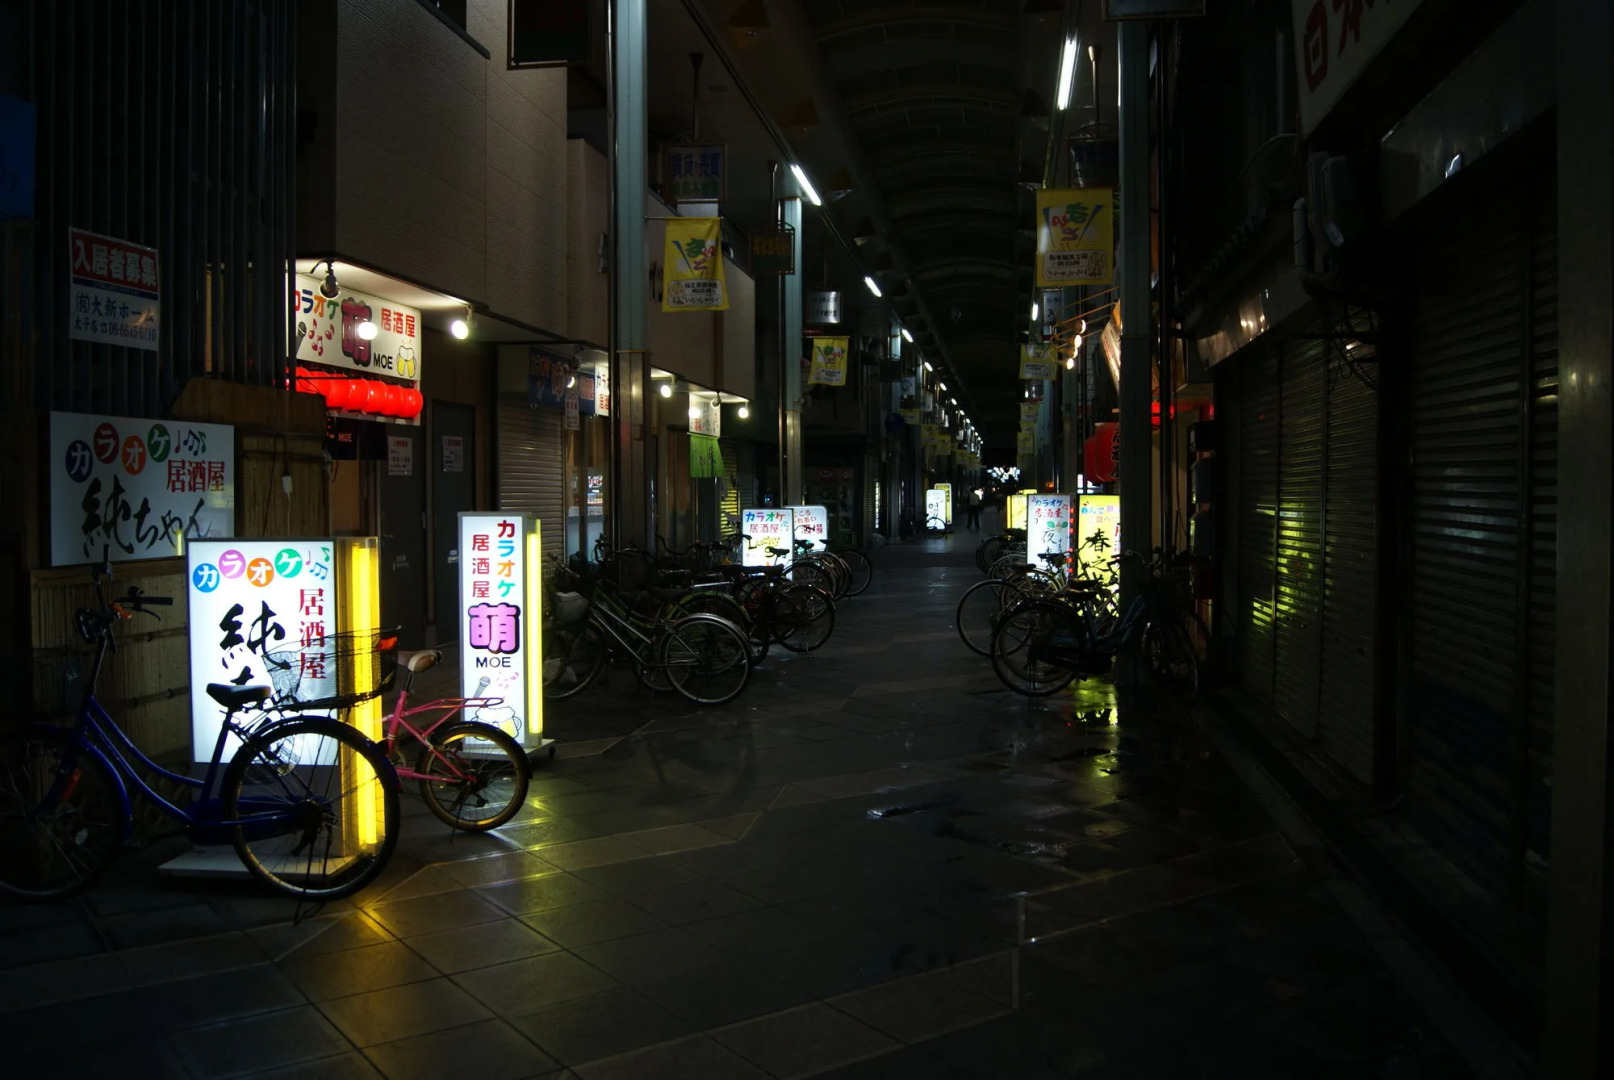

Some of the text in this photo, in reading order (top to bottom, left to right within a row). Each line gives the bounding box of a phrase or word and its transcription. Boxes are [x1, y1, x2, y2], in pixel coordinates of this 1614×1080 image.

[73, 239, 157, 287] 入居者募集
[381, 307, 415, 338] 居酒屋
[373, 352, 394, 370] MOE
[70, 428, 170, 476] カラオケ
[166, 459, 225, 493] 居酒屋
[81, 473, 213, 558] 純ちゃん
[745, 511, 786, 523] カラオケ
[749, 523, 779, 534] 居酒屋
[196, 550, 304, 590] カラオケ
[472, 534, 490, 598] 居酒屋
[497, 519, 516, 598] カラオケ
[299, 587, 327, 679] 居酒屋
[468, 602, 521, 655] 萌
[476, 656, 512, 668] MOE
